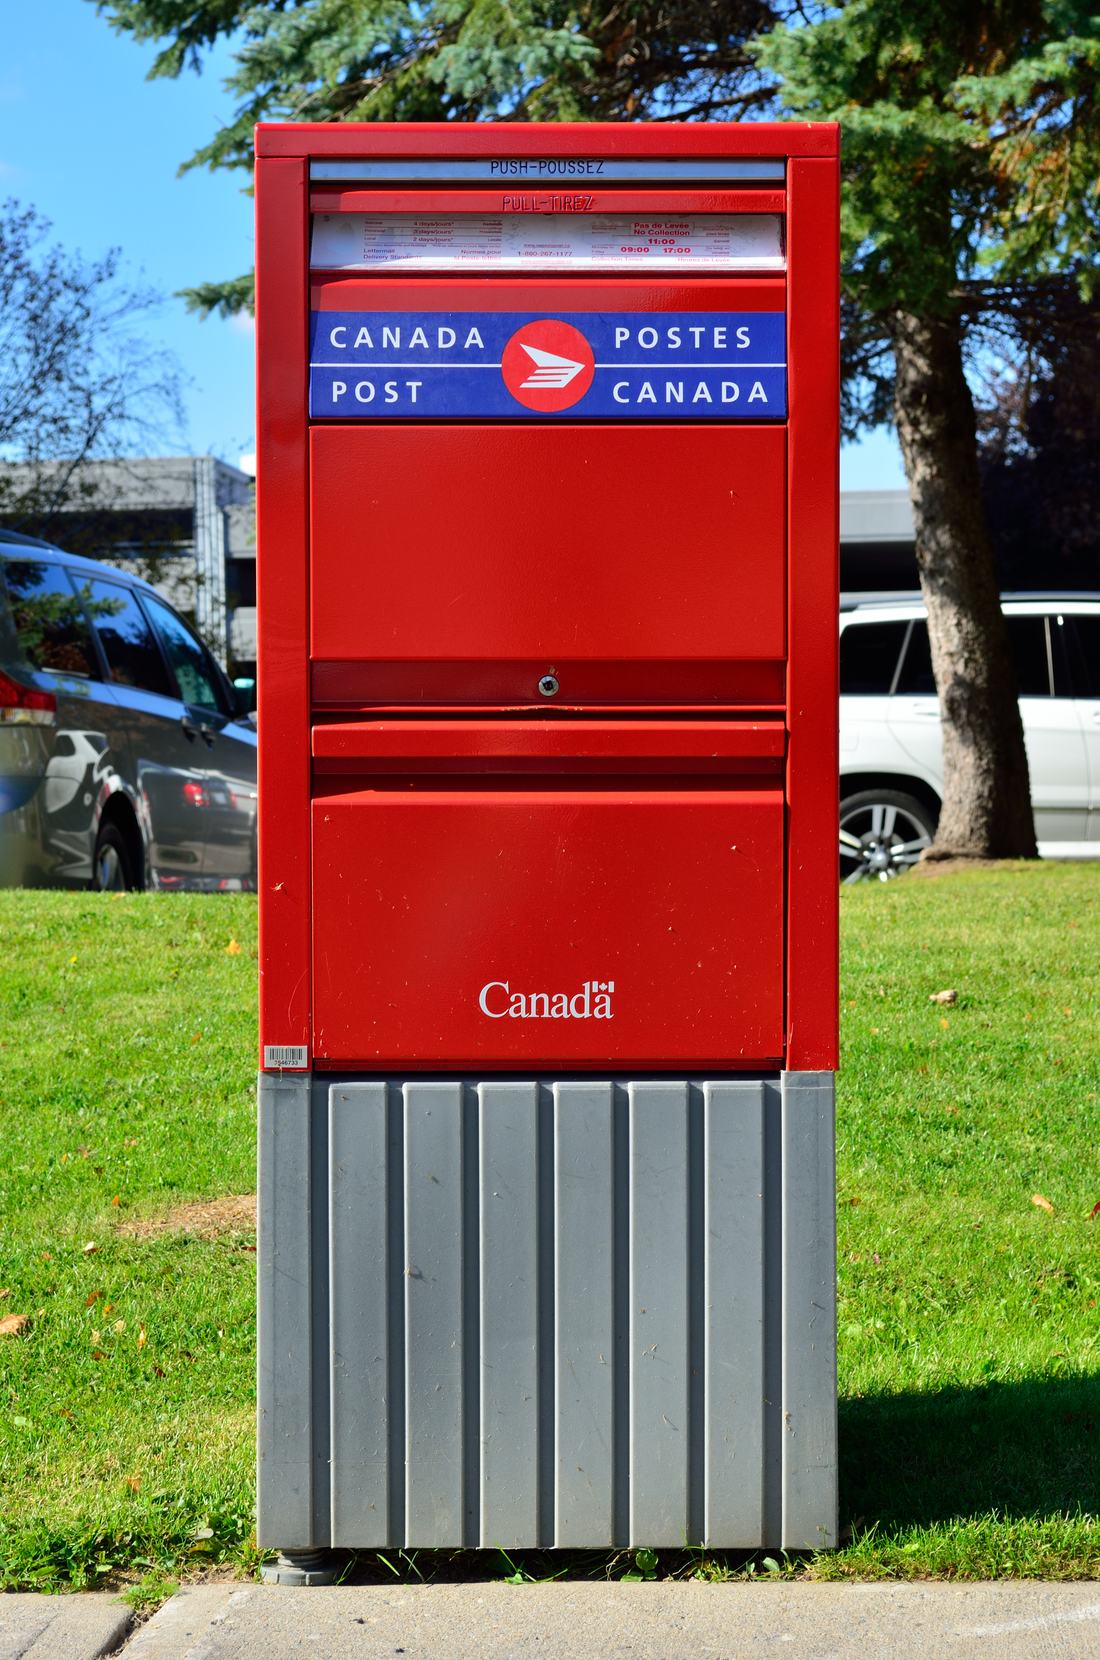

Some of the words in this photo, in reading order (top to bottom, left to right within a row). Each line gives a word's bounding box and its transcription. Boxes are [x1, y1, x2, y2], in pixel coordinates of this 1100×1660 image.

[490, 160, 604, 174] PUSH-POUSSEZ
[502, 195, 593, 211] PULL-TIREZ
[329, 326, 485, 349] CANADA
[615, 326, 751, 349] POSTES
[332, 381, 423, 403] POST
[612, 381, 769, 403] CANADA
[478, 980, 615, 1019] Canada
